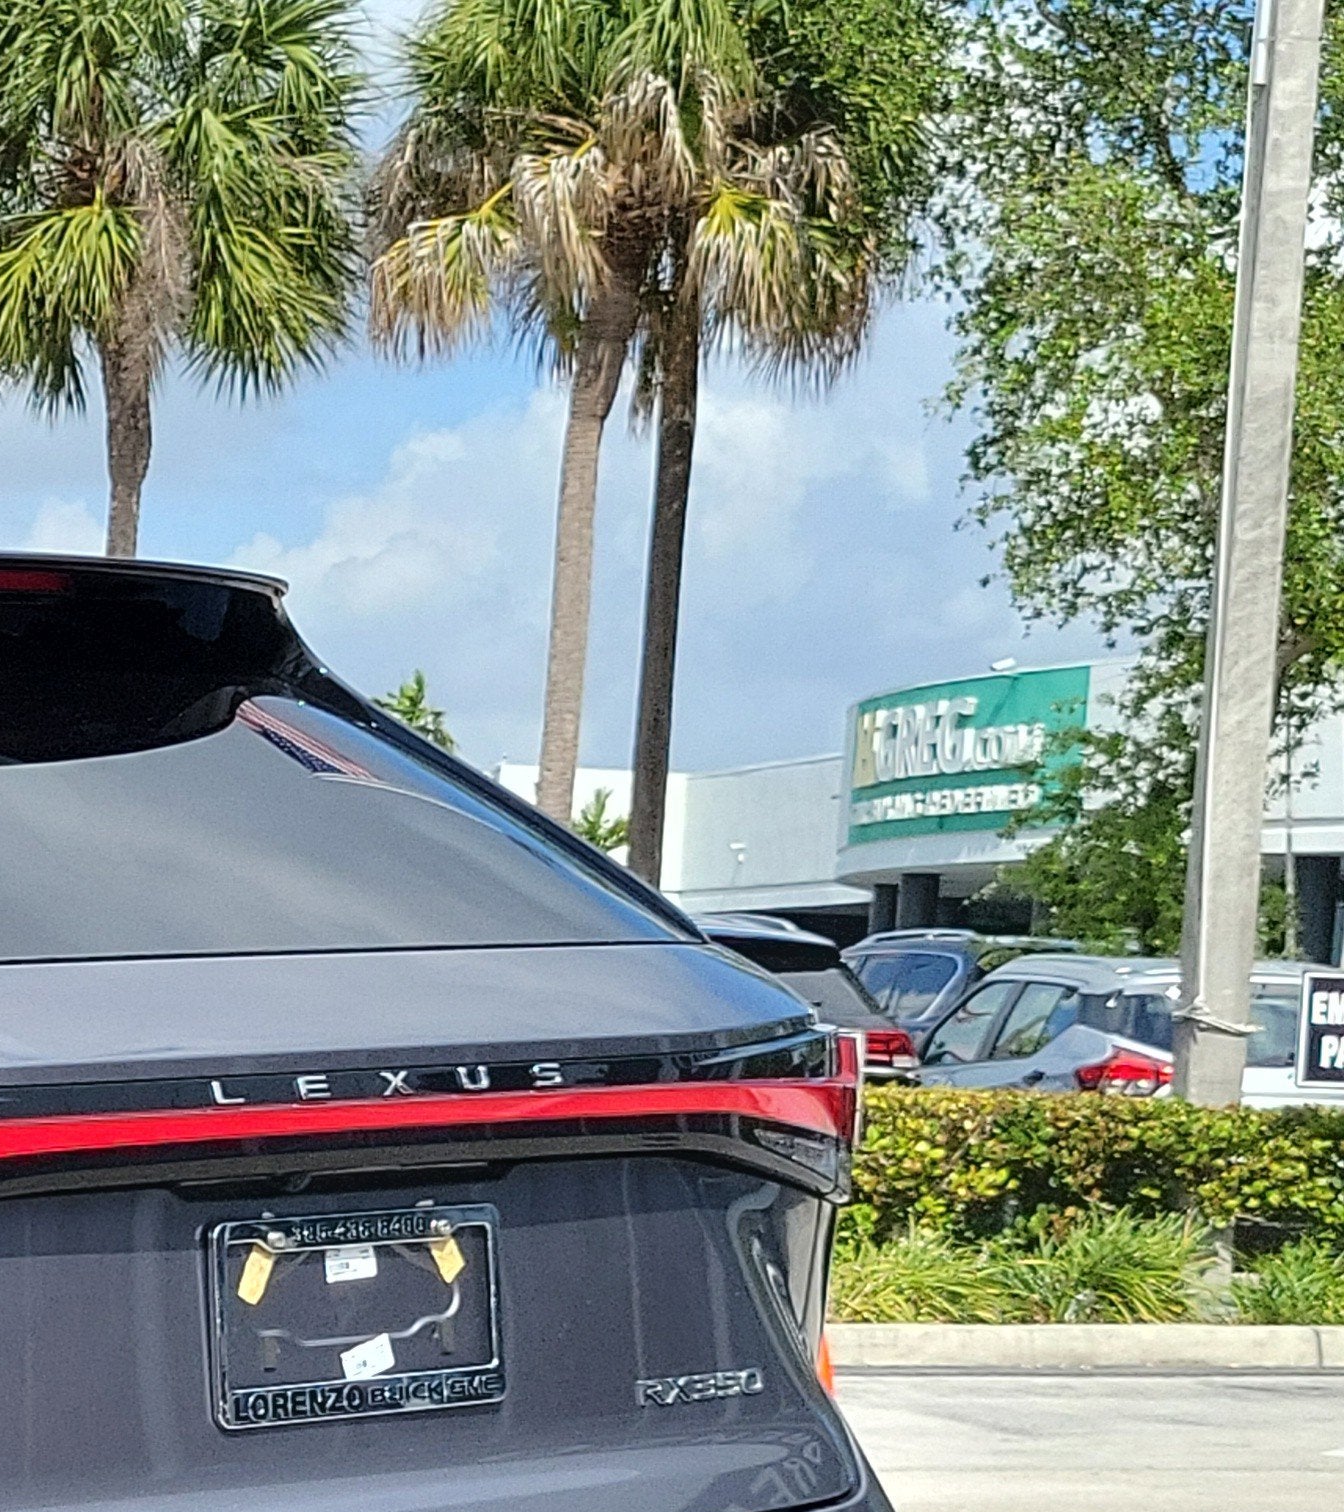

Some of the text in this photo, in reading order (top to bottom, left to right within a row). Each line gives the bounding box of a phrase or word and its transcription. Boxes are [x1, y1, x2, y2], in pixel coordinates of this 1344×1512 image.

[211, 1062, 563, 1104] LEXUS
[232, 1384, 363, 1423] LORENZO
[367, 1379, 443, 1406] BUICK
